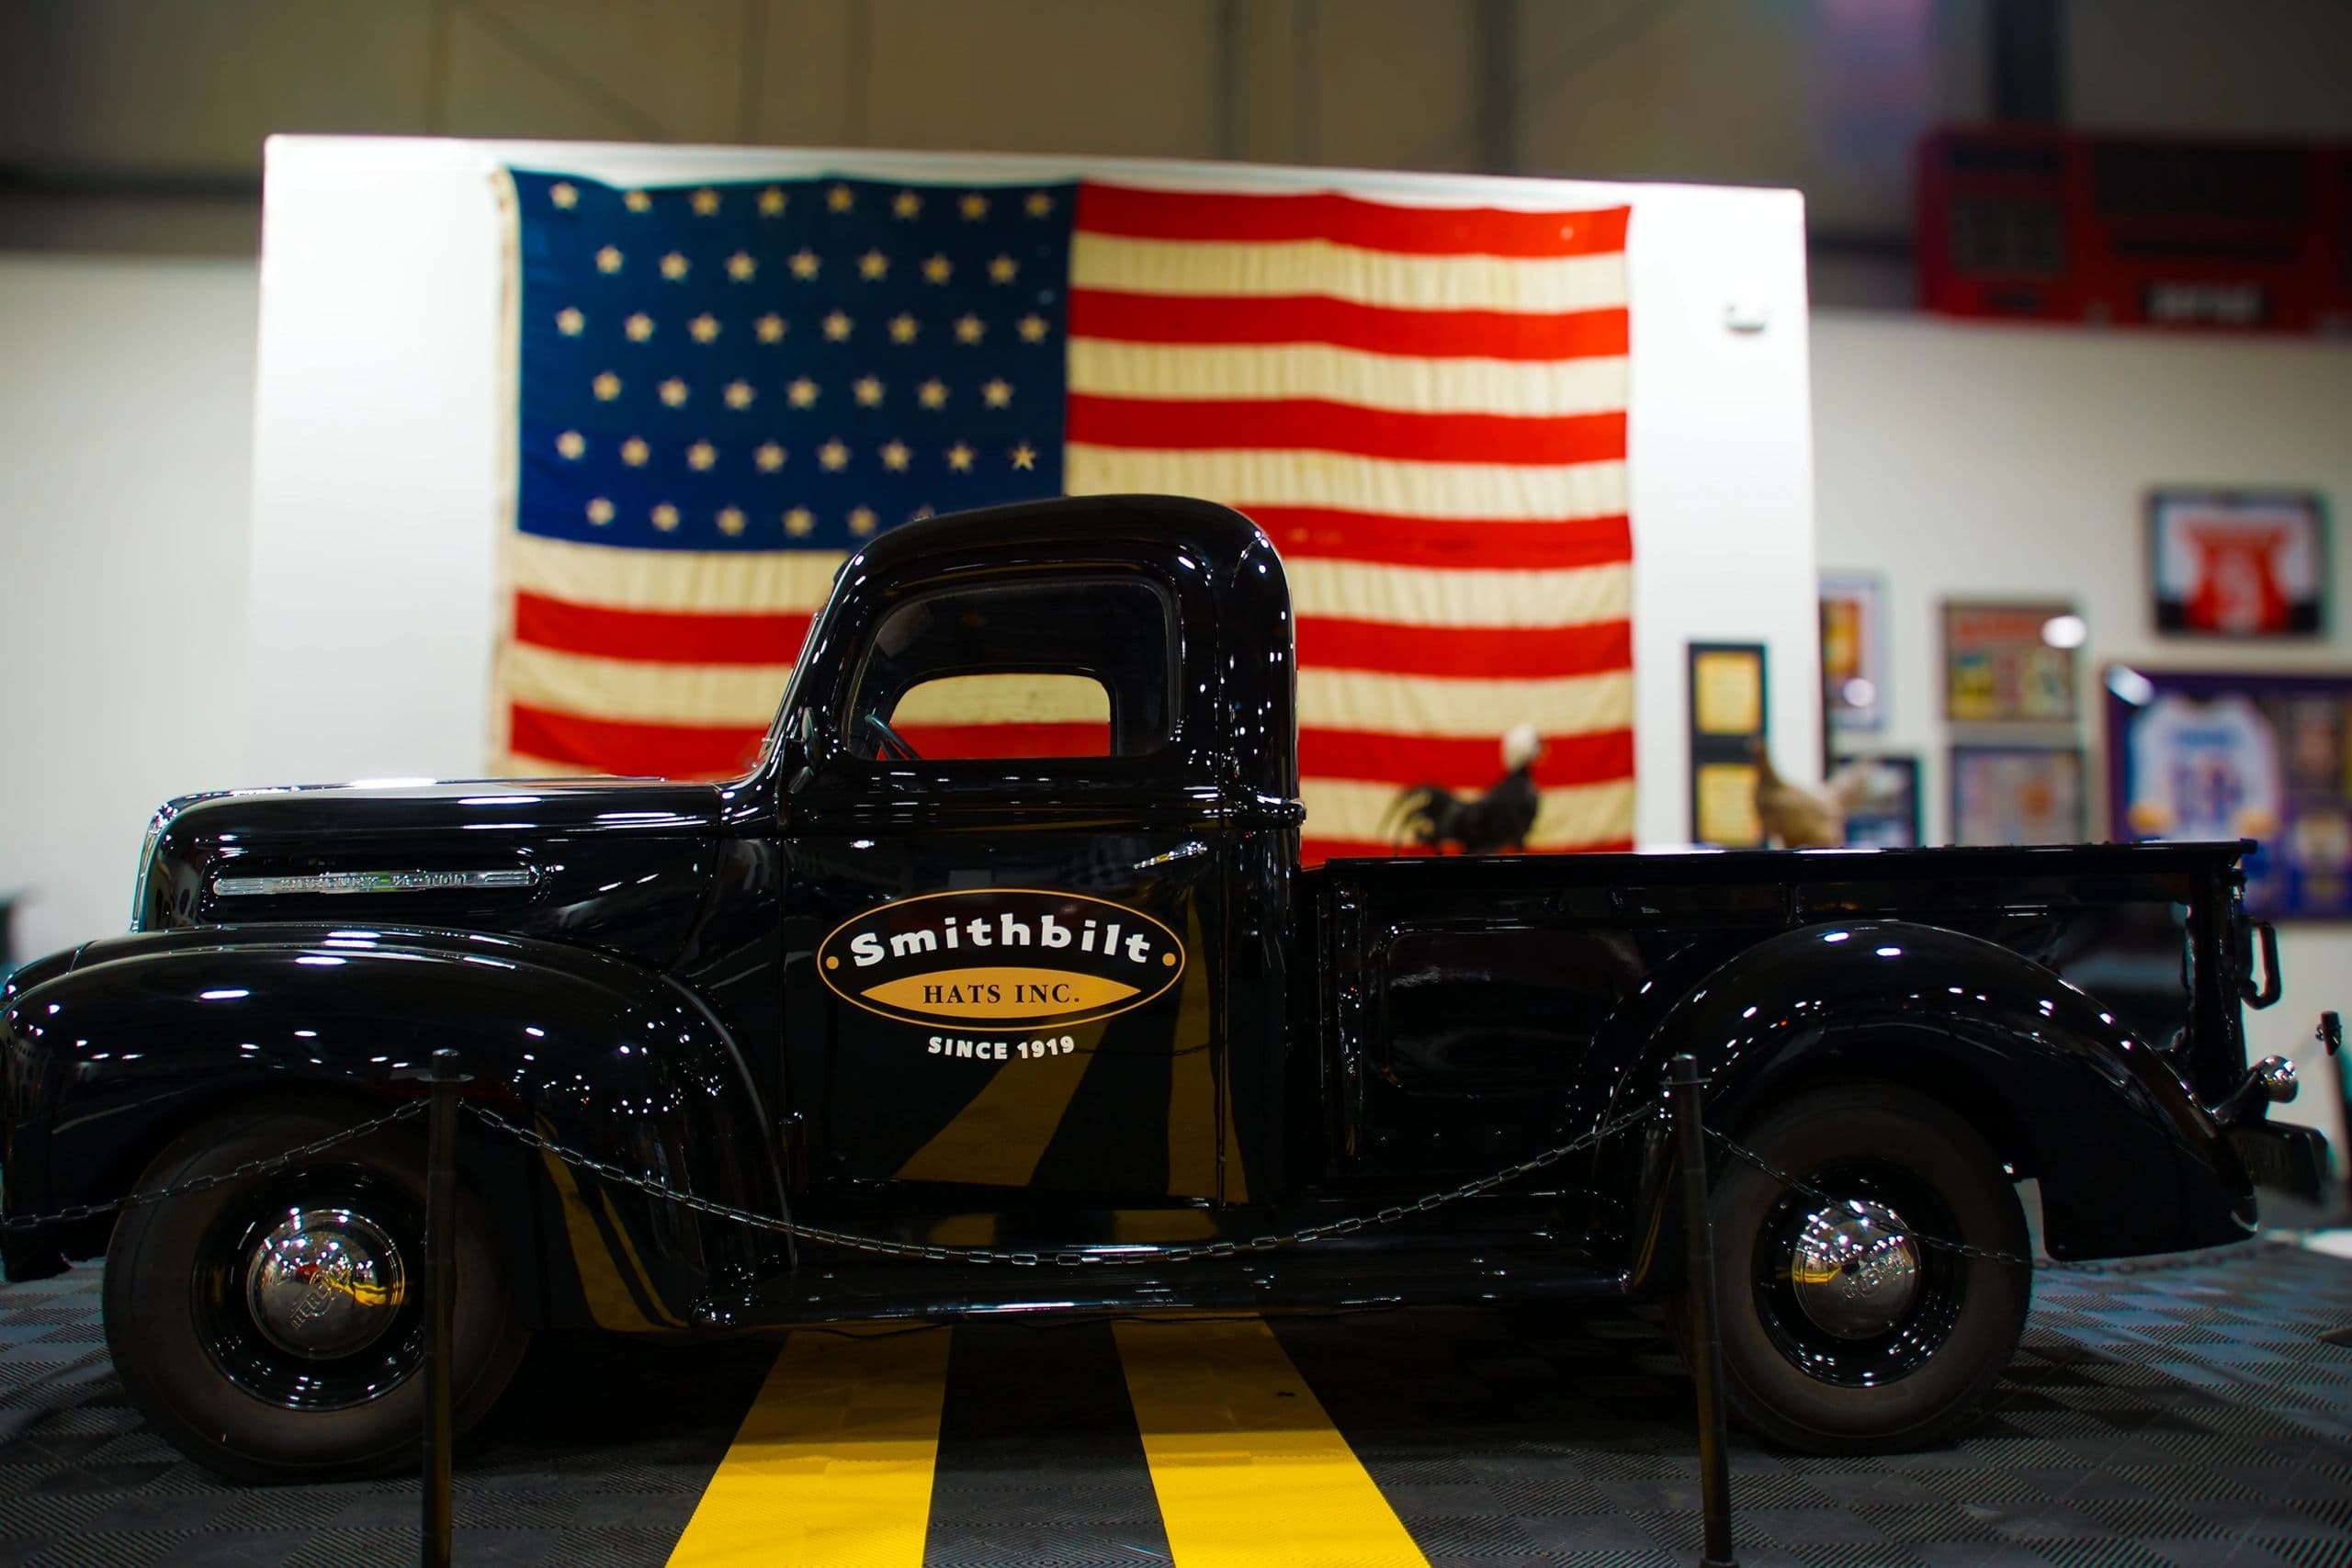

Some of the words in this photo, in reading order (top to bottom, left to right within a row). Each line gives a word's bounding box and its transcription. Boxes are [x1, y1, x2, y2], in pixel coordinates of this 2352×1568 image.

[850, 912, 1151, 967] Smithbilt
[922, 984, 1001, 1004] HATS
[1014, 983, 1080, 1004] INC.
[927, 1036, 1008, 1060] SINCE
[1016, 1035, 1075, 1059] 1919
